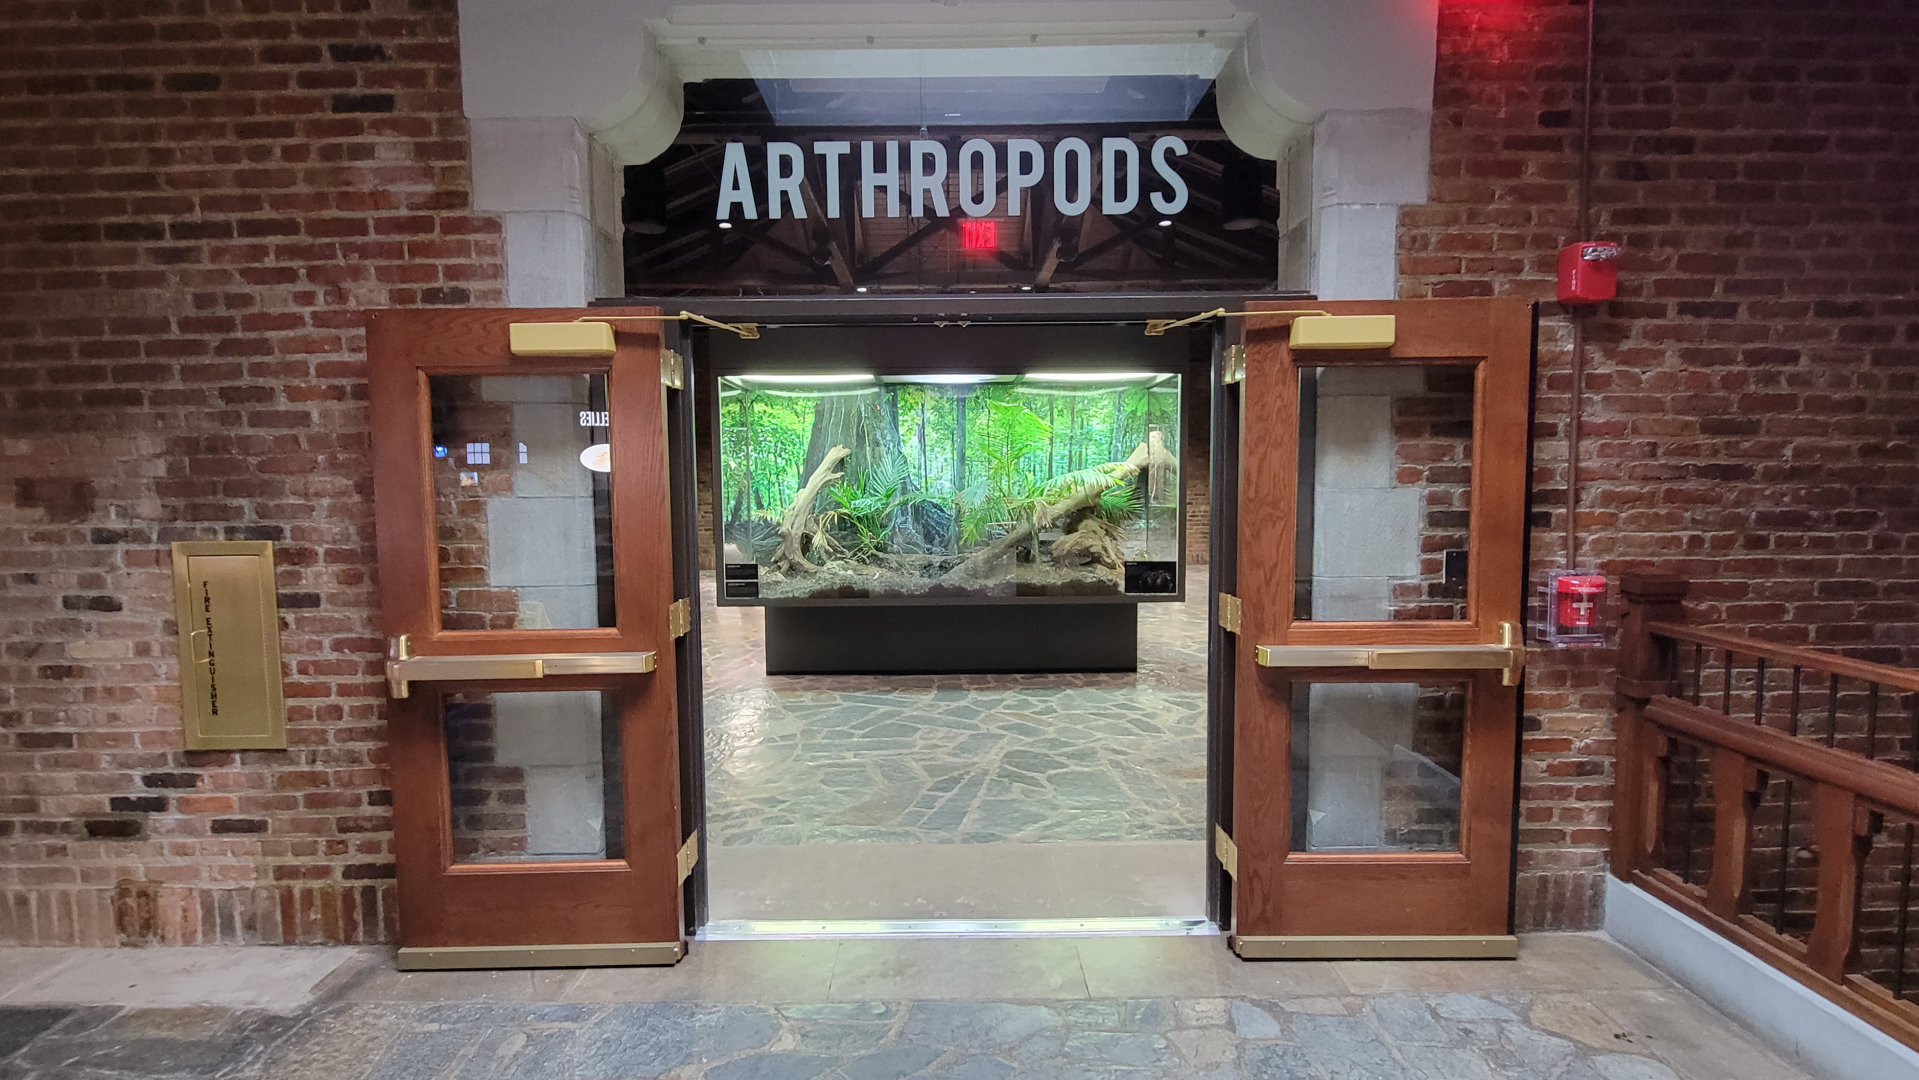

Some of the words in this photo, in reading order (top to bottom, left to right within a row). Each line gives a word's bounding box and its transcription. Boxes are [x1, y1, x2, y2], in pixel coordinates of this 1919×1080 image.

[715, 135, 1189, 220] ARTHROPODS
[203, 580, 211, 613] FIRE
[206, 617, 219, 716] EXTINGUISHER
